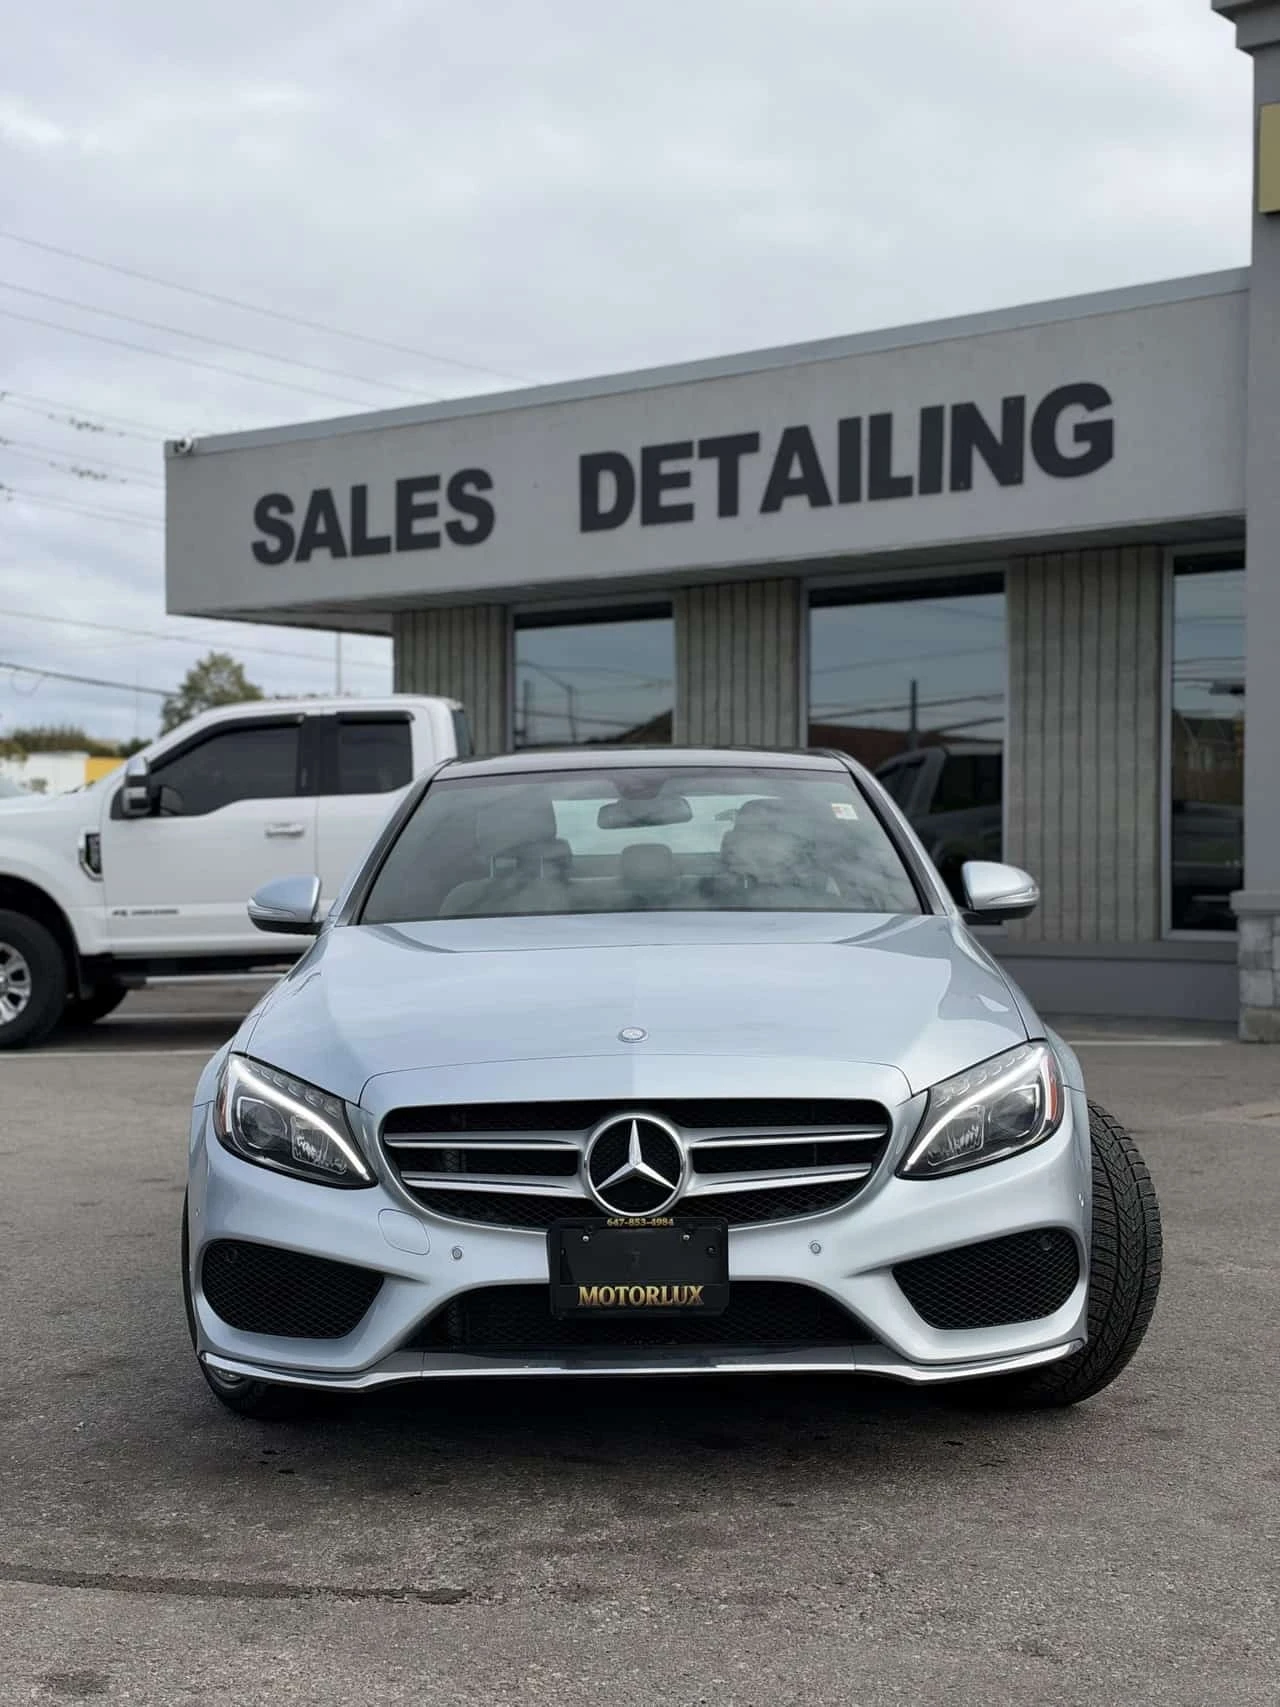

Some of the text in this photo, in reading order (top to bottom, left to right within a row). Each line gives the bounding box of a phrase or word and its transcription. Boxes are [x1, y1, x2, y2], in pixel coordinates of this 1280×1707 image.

[251, 382, 1115, 565] SALES DETAILING
[577, 1285, 705, 1306] MOTORLUX
